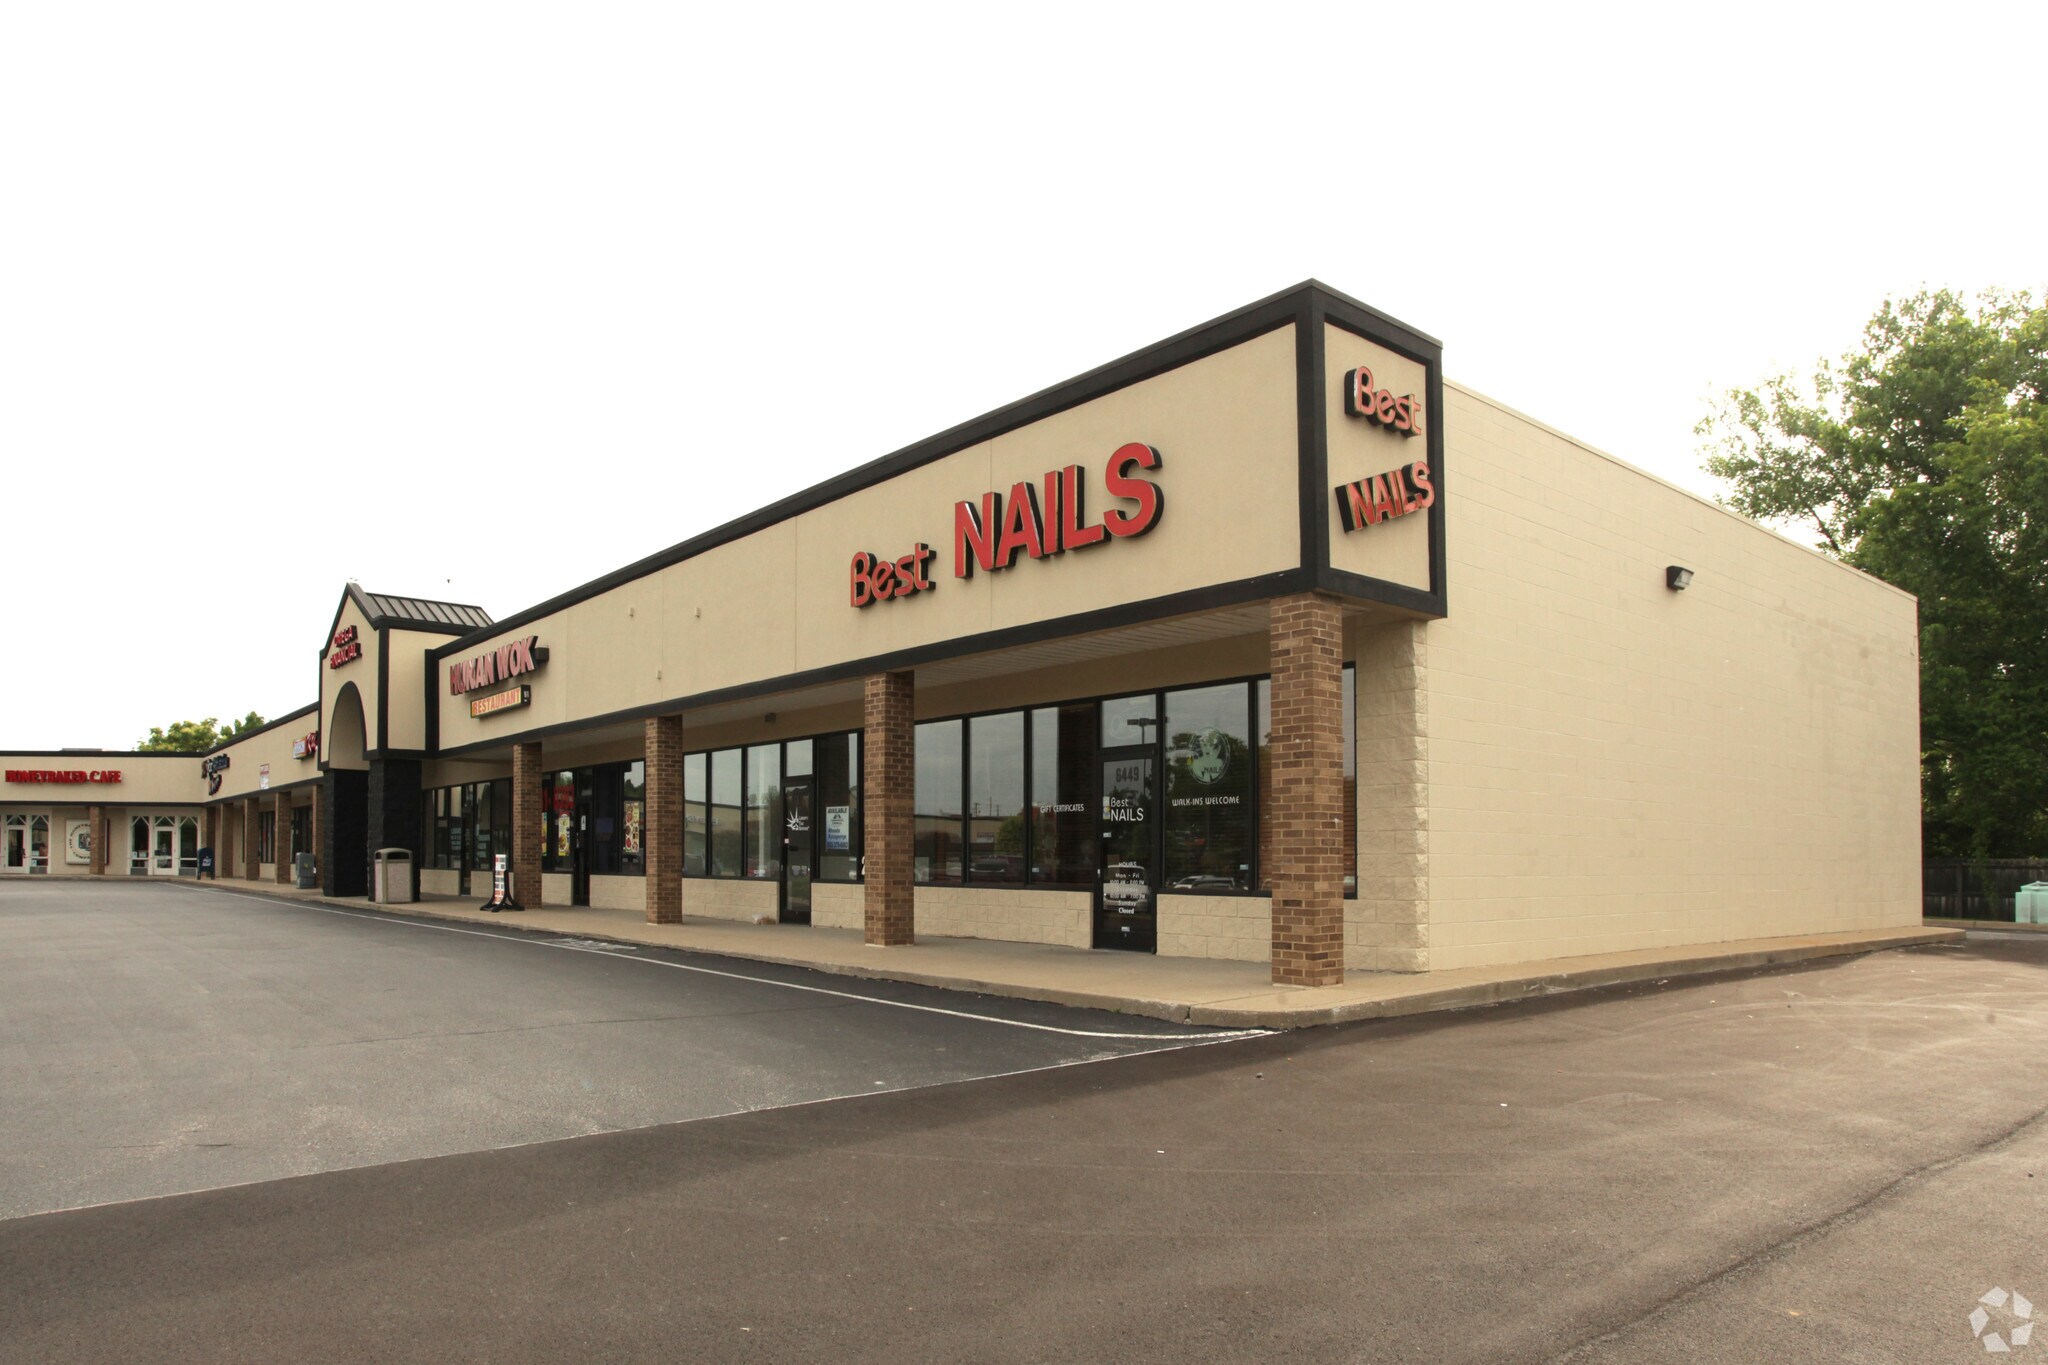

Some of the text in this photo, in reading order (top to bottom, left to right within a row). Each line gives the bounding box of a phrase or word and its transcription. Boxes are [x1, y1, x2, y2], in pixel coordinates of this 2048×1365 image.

[1344, 365, 1422, 437] Best
[1335, 460, 1435, 533] NAILS
[850, 442, 1164, 607] Best NAILS
[450, 636, 538, 696] HUNAN WOK
[472, 687, 521, 715] RESTAURANT
[5, 770, 122, 784] HONEYBAKED CAFE
[1040, 803, 1085, 814] GIFT CERTIFICATES
[1110, 797, 1129, 808] Best
[1172, 796, 1240, 807] WALK-INS WELCOME
[1110, 807, 1144, 822] NAILS
